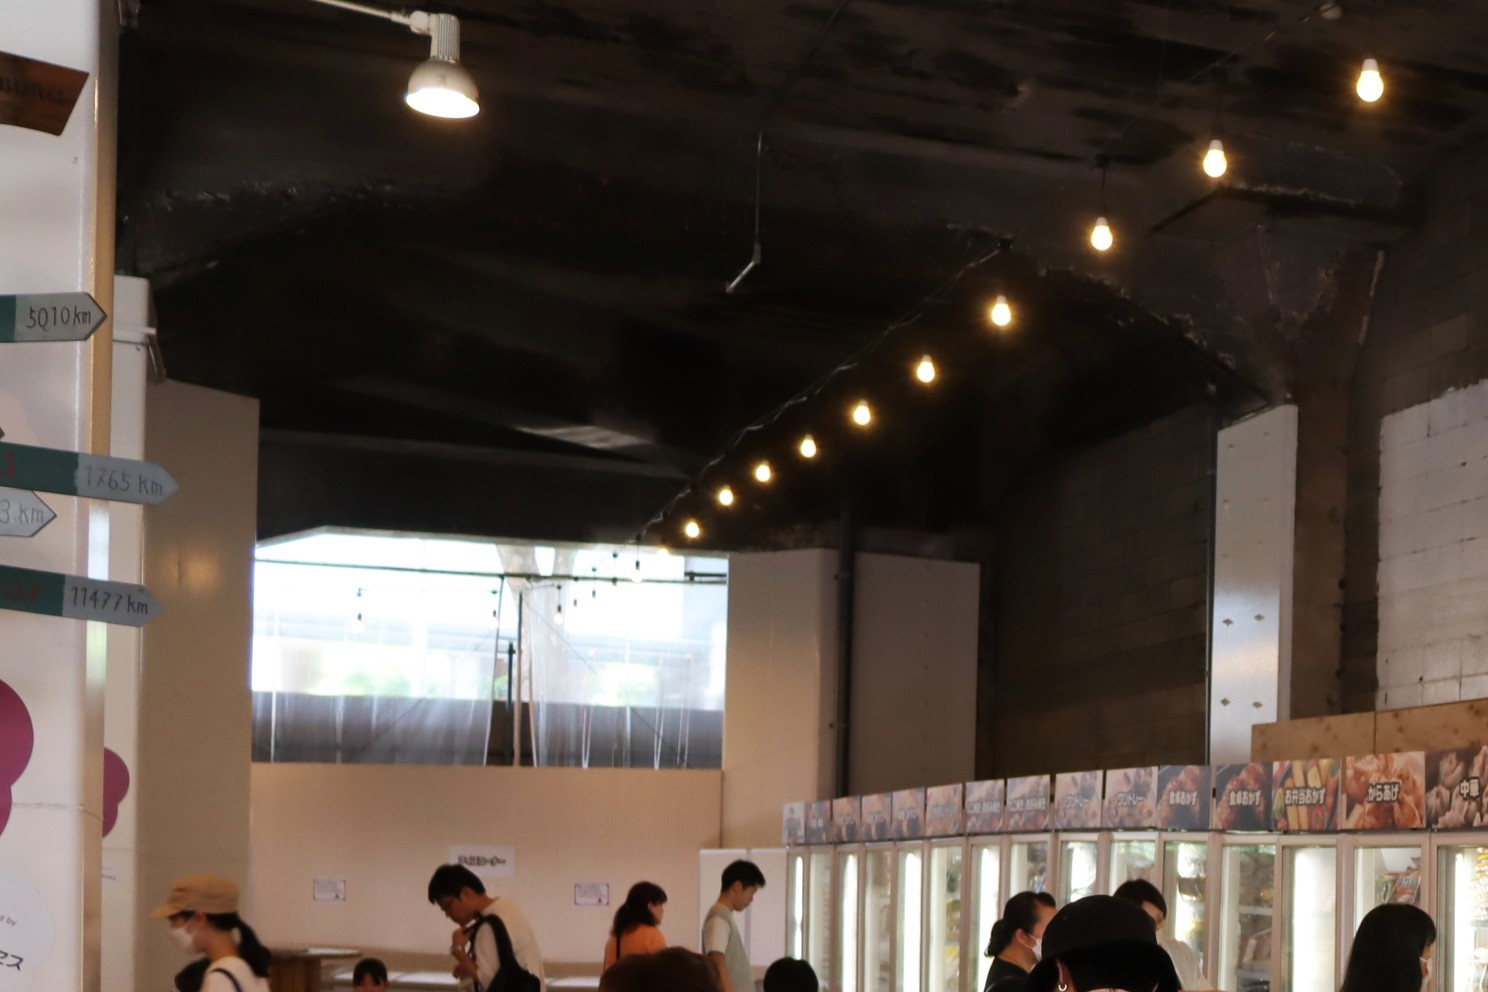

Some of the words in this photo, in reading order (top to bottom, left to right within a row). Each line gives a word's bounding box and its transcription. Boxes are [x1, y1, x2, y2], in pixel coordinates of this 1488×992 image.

[19, 501, 44, 525] km
[1284, 787, 1326, 804] お弁当おかず
[1367, 783, 1401, 802] からあげ
[1458, 776, 1480, 798] 中華
[1229, 790, 1261, 806] 食卓おかず
